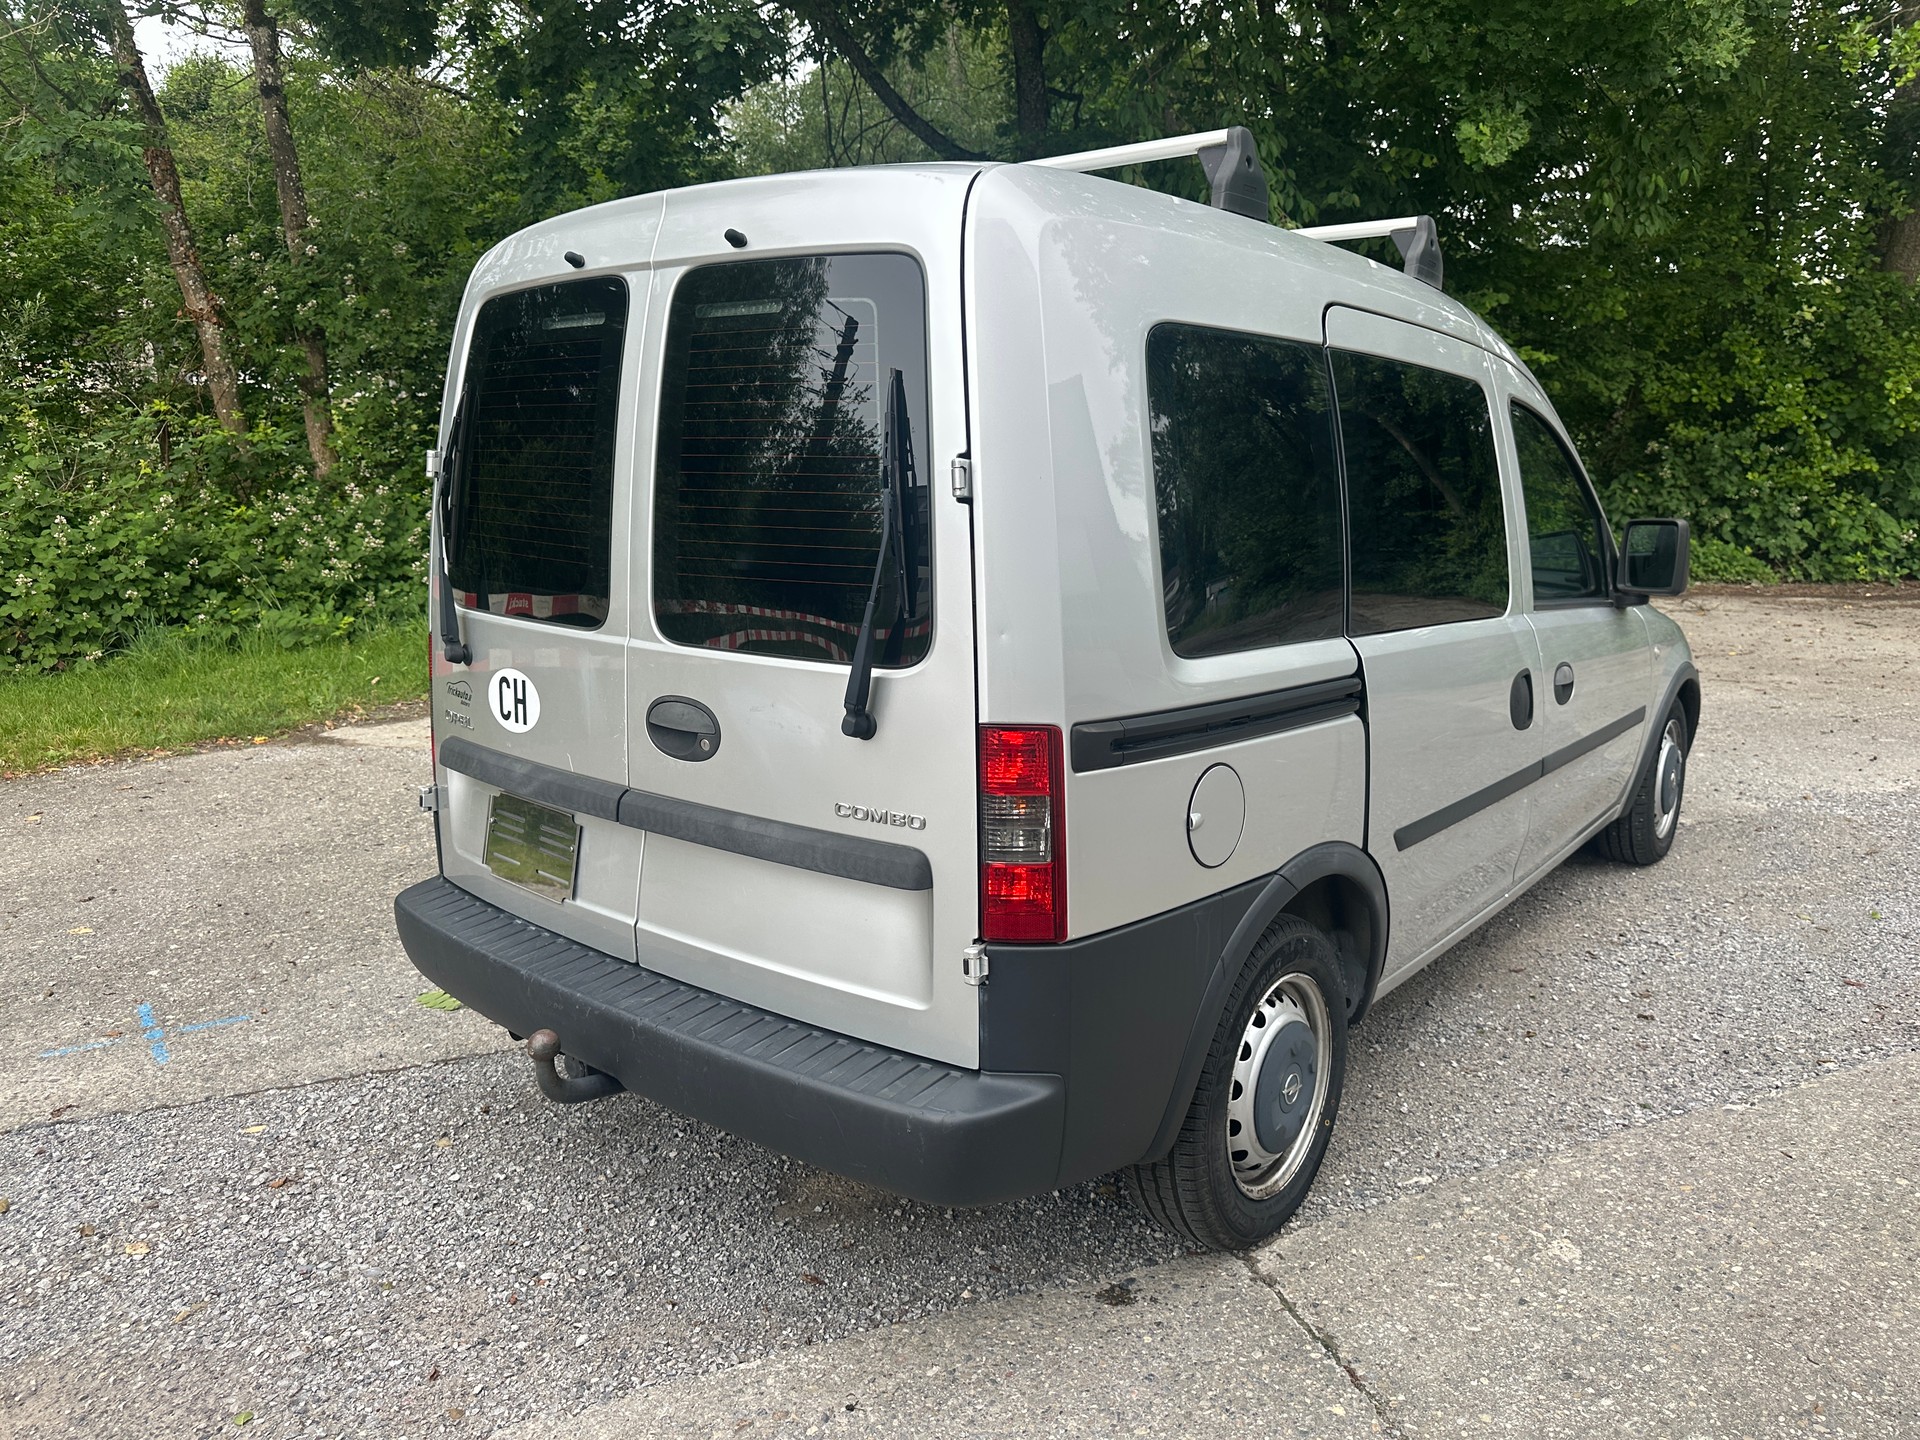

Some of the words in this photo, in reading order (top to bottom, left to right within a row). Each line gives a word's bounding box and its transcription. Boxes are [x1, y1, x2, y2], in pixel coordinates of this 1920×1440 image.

[498, 676, 528, 726] CH
[445, 709, 475, 731] OPEL
[834, 802, 927, 830] COMBO
